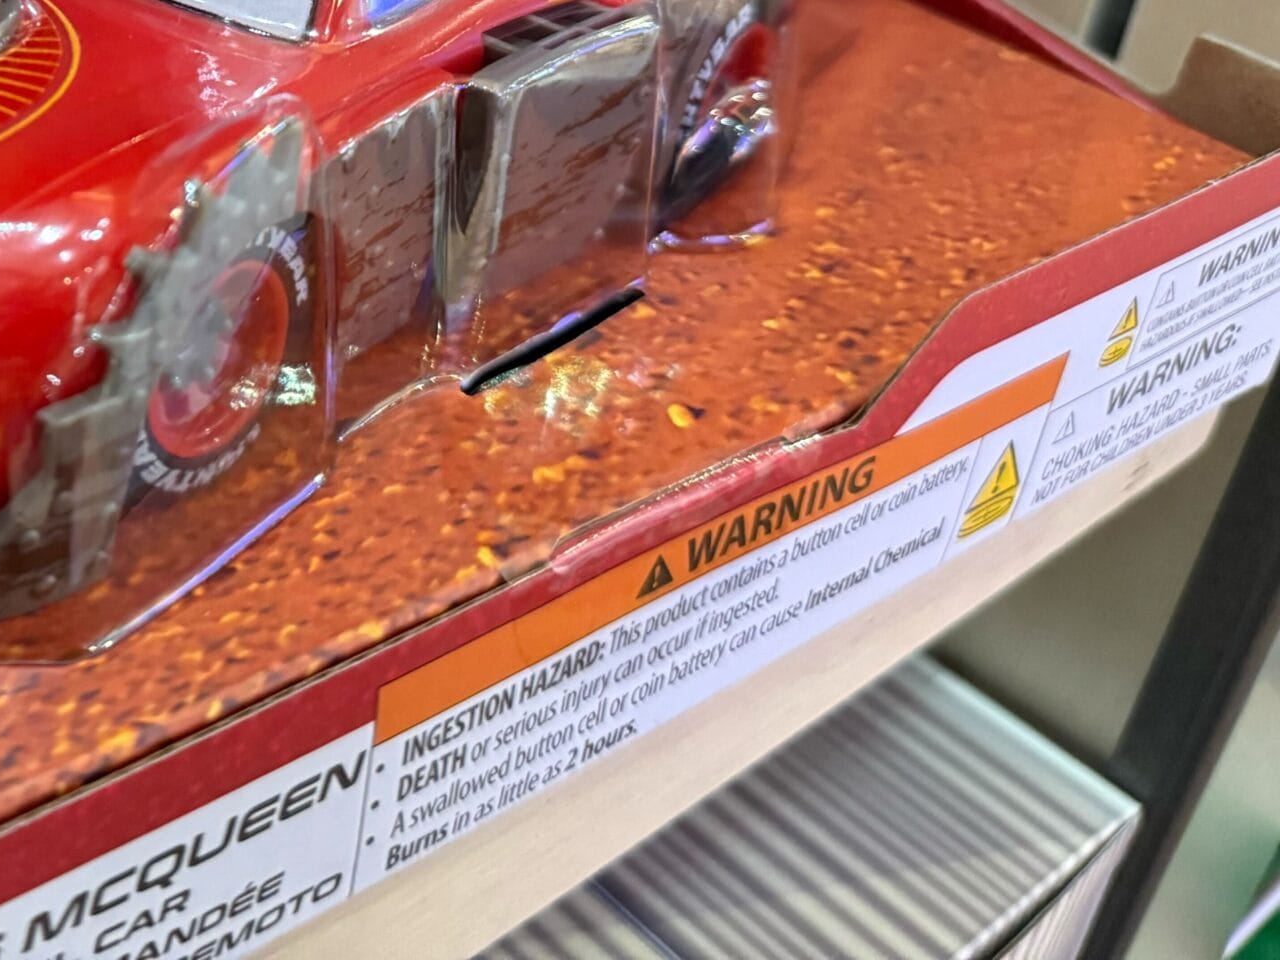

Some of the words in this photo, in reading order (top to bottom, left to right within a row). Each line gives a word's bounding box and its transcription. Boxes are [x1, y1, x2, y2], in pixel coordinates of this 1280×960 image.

[1199, 224, 1280, 288] WARNIN
[1031, 470, 1064, 506] NOT
[1061, 460, 1090, 486] FOR
[1088, 422, 1154, 472] CHILDREN
[1152, 398, 1200, 438] UNDER
[1208, 370, 1249, 405] YEARS
[1041, 427, 1117, 481] CHOKING
[1117, 388, 1181, 438] HAZARD
[1190, 362, 1230, 398] SMALL
[1230, 338, 1273, 375] PARTS
[1106, 324, 1243, 415] WARNING:
[687, 455, 876, 572] WARNING
[389, 810, 407, 838] A
[408, 753, 512, 828] swallowed
[513, 722, 574, 771] button
[576, 696, 605, 735] cell
[609, 692, 634, 715] or
[630, 672, 670, 706] coin
[668, 634, 726, 685] battery
[728, 623, 757, 652] can
[759, 601, 804, 637] cause
[804, 556, 874, 613] Internal
[873, 515, 946, 574] Chemical
[401, 685, 517, 766] INGESTION
[519, 639, 606, 705] HAZARD:
[610, 617, 643, 655] This
[643, 580, 712, 642] product
[710, 557, 778, 603] contains
[776, 548, 791, 568] a
[790, 528, 843, 561] button
[843, 500, 872, 534] cell
[869, 498, 888, 521] or
[888, 480, 919, 512] coin
[918, 455, 971, 496] battery.
[396, 743, 468, 802] DEATH
[470, 733, 494, 762] or
[493, 698, 558, 750] serious
[558, 669, 612, 715] injury
[613, 653, 644, 682] can
[646, 631, 694, 666] occur
[693, 617, 713, 642] if
[706, 578, 781, 634] ingested.
[21, 749, 366, 954] MCQUEEN
[384, 823, 448, 871] Burns
[451, 810, 471, 835] in
[473, 801, 494, 822] as
[496, 771, 540, 810] little
[541, 760, 563, 784] as
[564, 750, 580, 771] 2
[580, 718, 638, 764] hours.
[93, 888, 191, 954] CAR
